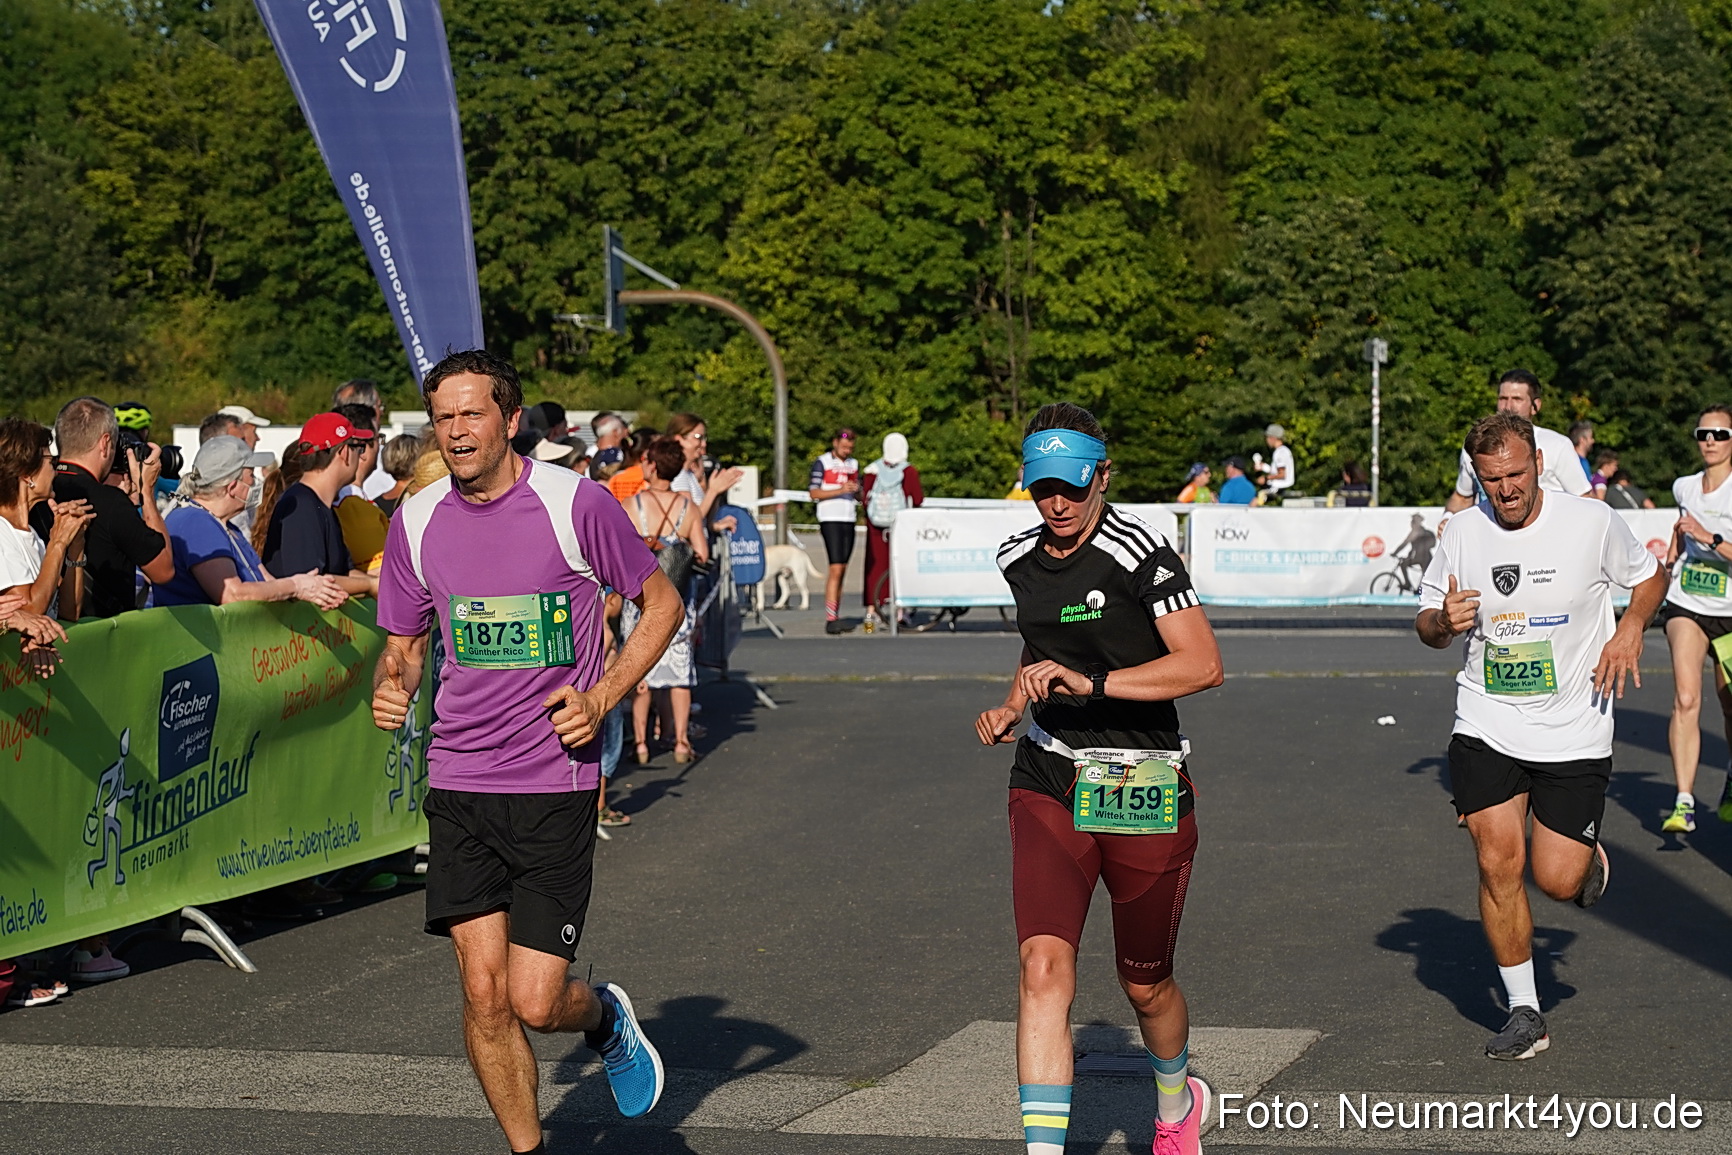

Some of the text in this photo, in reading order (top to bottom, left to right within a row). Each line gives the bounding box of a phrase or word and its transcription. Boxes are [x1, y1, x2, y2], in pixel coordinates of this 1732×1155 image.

[917, 528, 952, 541] NOW
[1215, 529, 1249, 541] NOW
[1216, 551, 1269, 564] E-BIKES
[1271, 552, 1281, 563] &
[1526, 568, 1557, 577] Autohaus
[1688, 569, 1720, 586] 1470
[1060, 610, 1103, 624] neumarkt
[1061, 602, 1087, 616] physio
[1491, 612, 1526, 623] GLAS
[1545, 616, 1566, 624] Seger
[455, 628, 465, 653] RUN
[463, 620, 527, 647] 1873
[528, 624, 540, 657] 2022
[1494, 621, 1526, 641] Götz
[252, 617, 358, 684] Gesunde Firmen
[468, 646, 525, 657] Günther Rico
[1486, 665, 1494, 685] RUN
[1492, 660, 1543, 680] 1225
[1543, 661, 1554, 688] 2022
[1500, 680, 1521, 688] Seger
[281, 672, 322, 722] laufen
[170, 693, 213, 722] Fischer
[173, 712, 207, 732] AUTOMOBILE
[1084, 750, 1124, 758] performance
[132, 730, 261, 846] firmenlauf
[1094, 785, 1162, 810] 1159
[1080, 791, 1091, 816] RUN
[1163, 788, 1174, 823] 2022
[1094, 809, 1159, 821] Wittek Thekla
[132, 827, 190, 875] neumarkt
[216, 811, 362, 880] www.firmenlauf-oberpfalz.de
